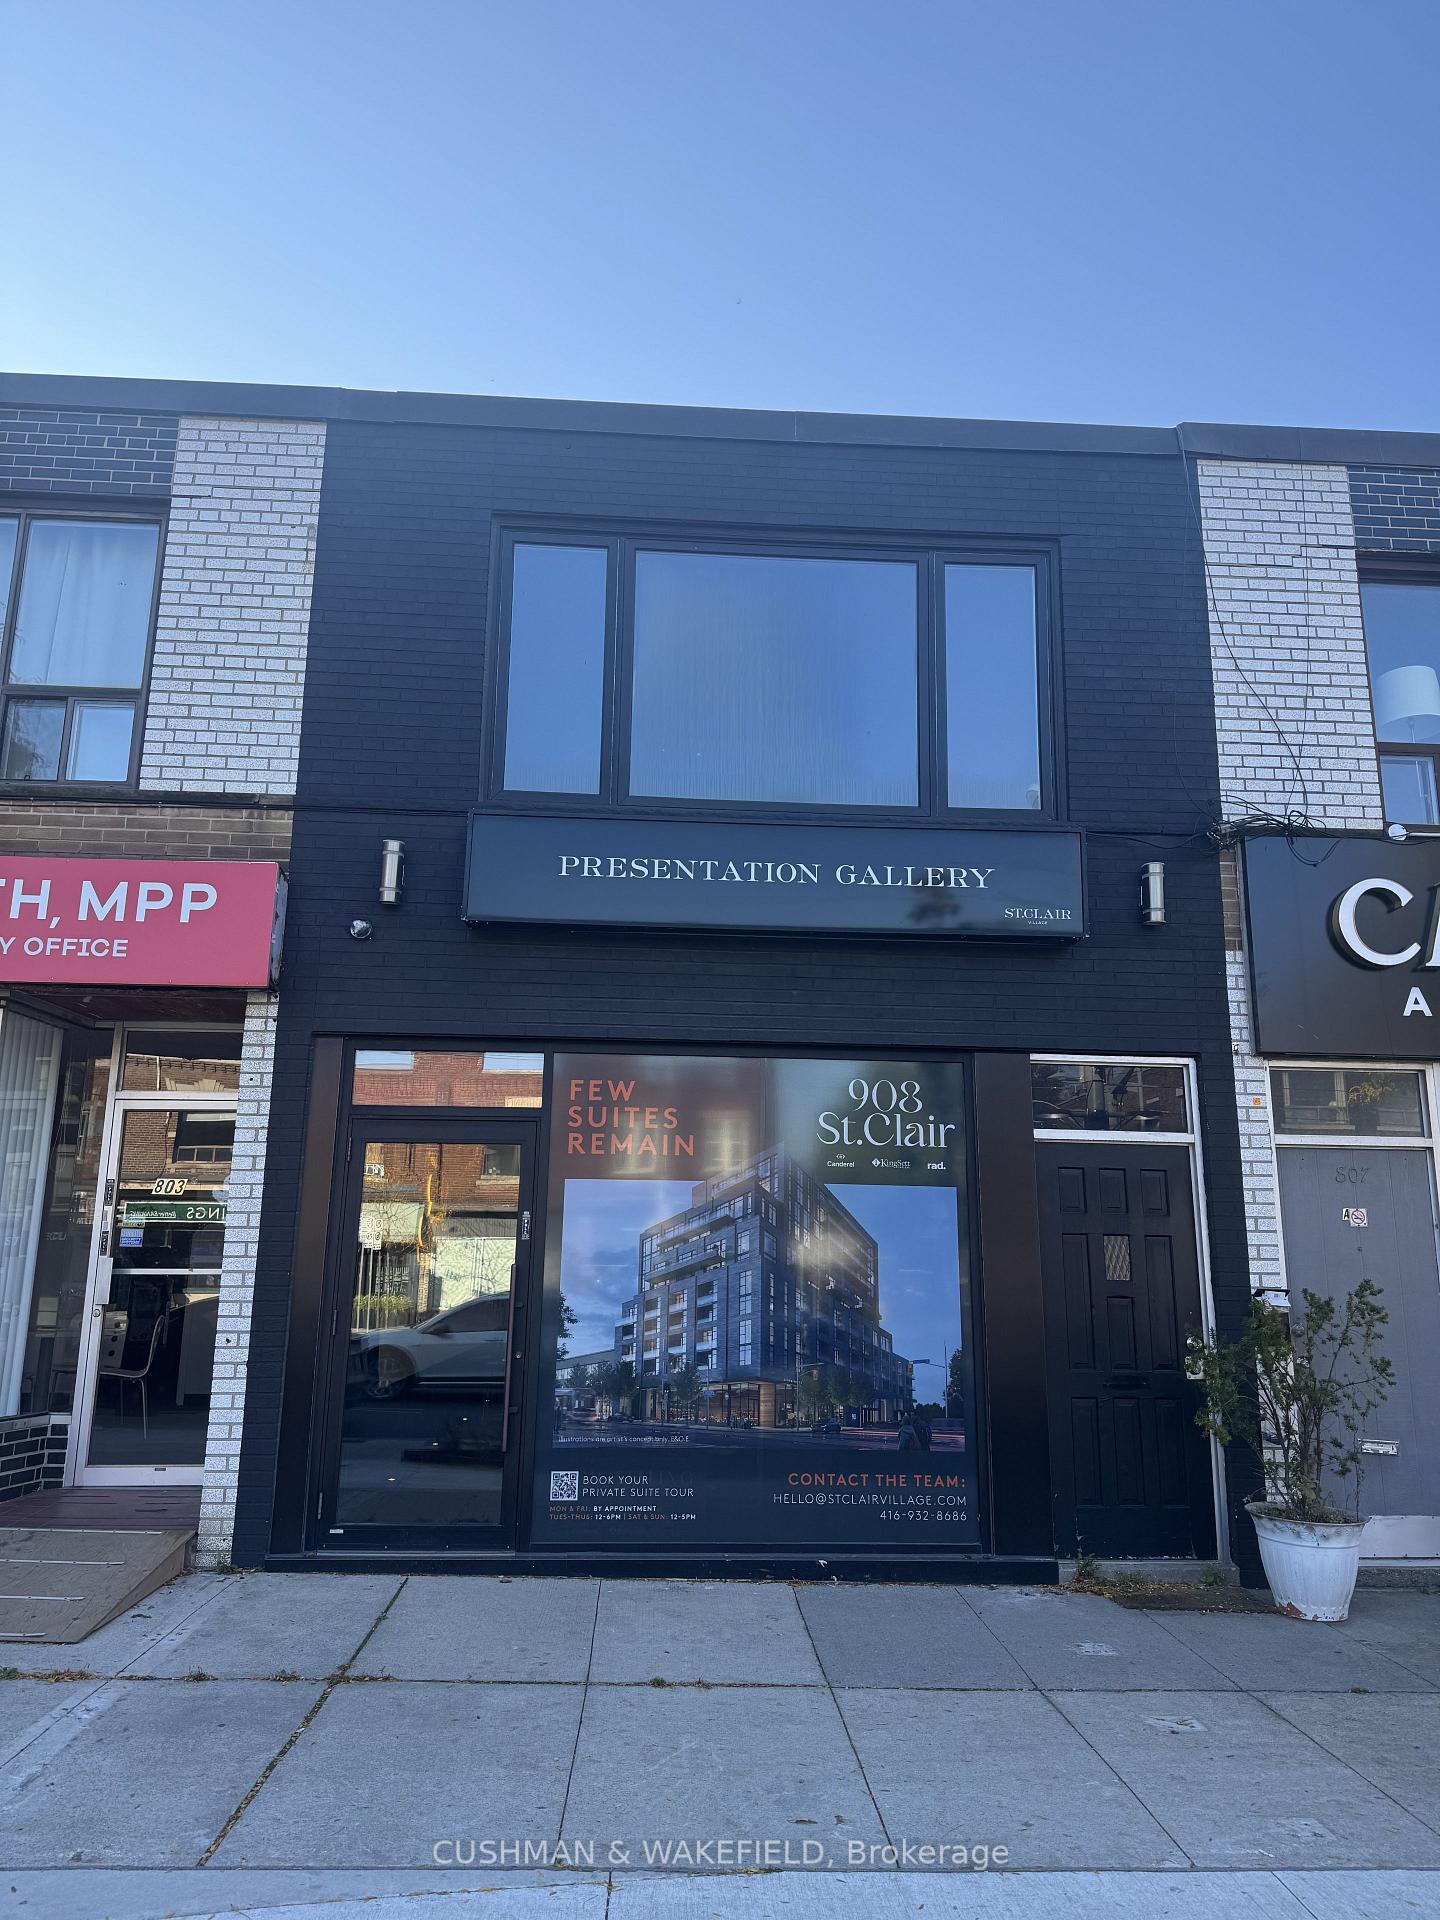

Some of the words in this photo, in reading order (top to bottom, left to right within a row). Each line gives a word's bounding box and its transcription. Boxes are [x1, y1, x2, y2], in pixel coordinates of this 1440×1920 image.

[558, 855, 822, 884] PRESENTATION
[835, 863, 996, 889] GALLERY
[0, 878, 61, 929] H,
[77, 880, 218, 923] MPP
[1338, 877, 1440, 967] C
[23, 937, 129, 958] OFFICE
[1402, 986, 1433, 1017] A
[570, 1079, 636, 1101] FEW
[848, 1078, 923, 1113] 908
[567, 1105, 679, 1129] SUITES
[567, 1132, 695, 1156] REMAIN
[827, 1160, 855, 1168] Canderel
[927, 1161, 947, 1171] rad.
[154, 1179, 185, 1194] 803
[583, 1475, 614, 1485] BOOK
[618, 1475, 649, 1485] YOUR
[788, 1473, 868, 1486] CONTACT
[875, 1474, 907, 1487] THE
[913, 1474, 966, 1488] TEAM:
[582, 1488, 626, 1497] PRIVATE
[630, 1488, 660, 1497] SUITE
[664, 1488, 694, 1497] TOUR
[773, 1493, 967, 1506] HELLO@STCLAIRVILLAGE.COM
[879, 1510, 967, 1521] 416-932-8686
